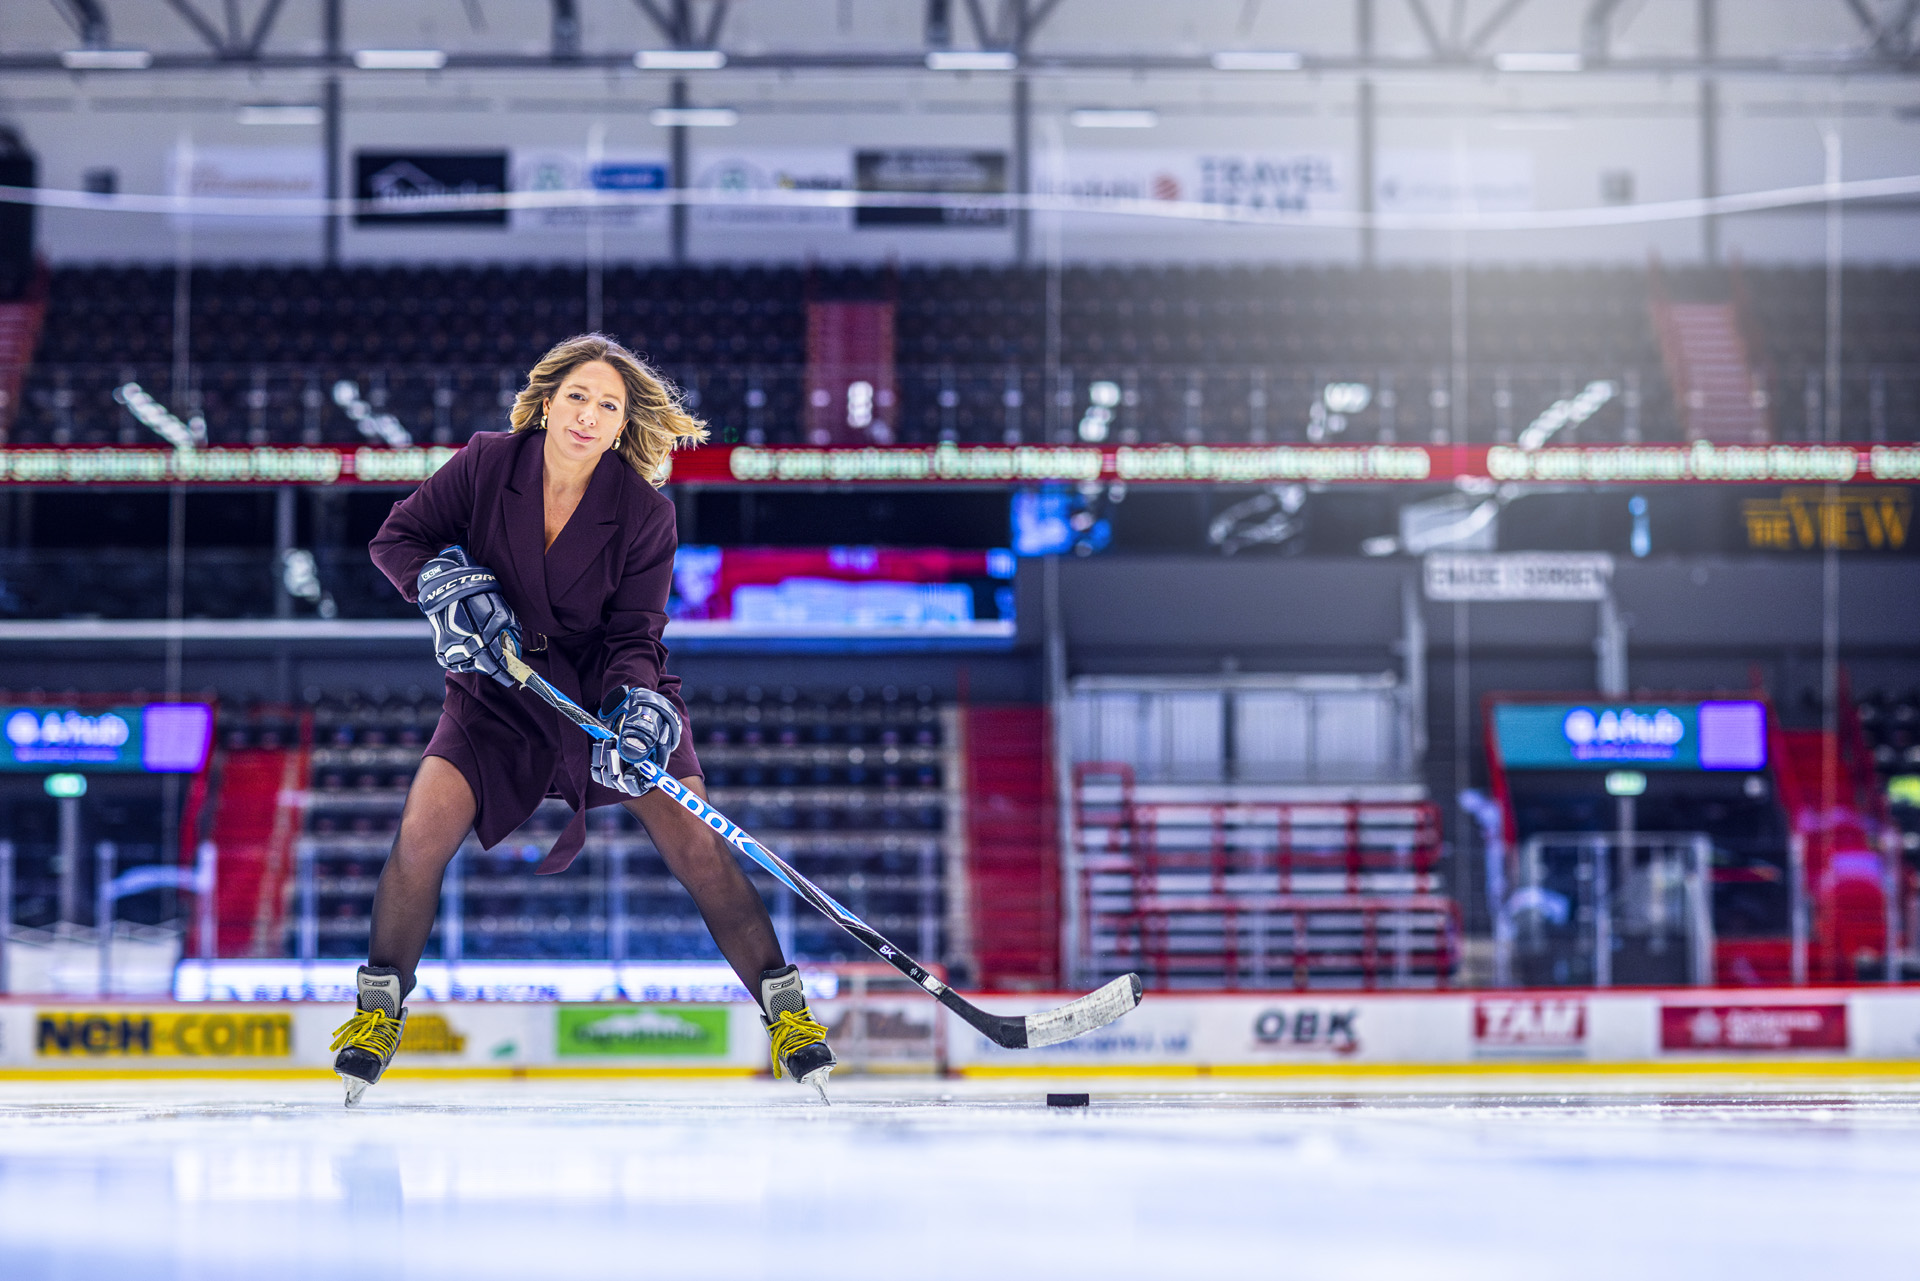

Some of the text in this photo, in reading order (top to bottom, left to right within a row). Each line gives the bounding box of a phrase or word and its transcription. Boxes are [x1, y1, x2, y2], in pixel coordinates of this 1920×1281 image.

[1791, 498, 1909, 548] VIEW
[425, 574, 496, 602] VECTOR
[633, 759, 756, 853] eebok
[879, 944, 897, 960] 6K
[1253, 1007, 1359, 1042] OBK
